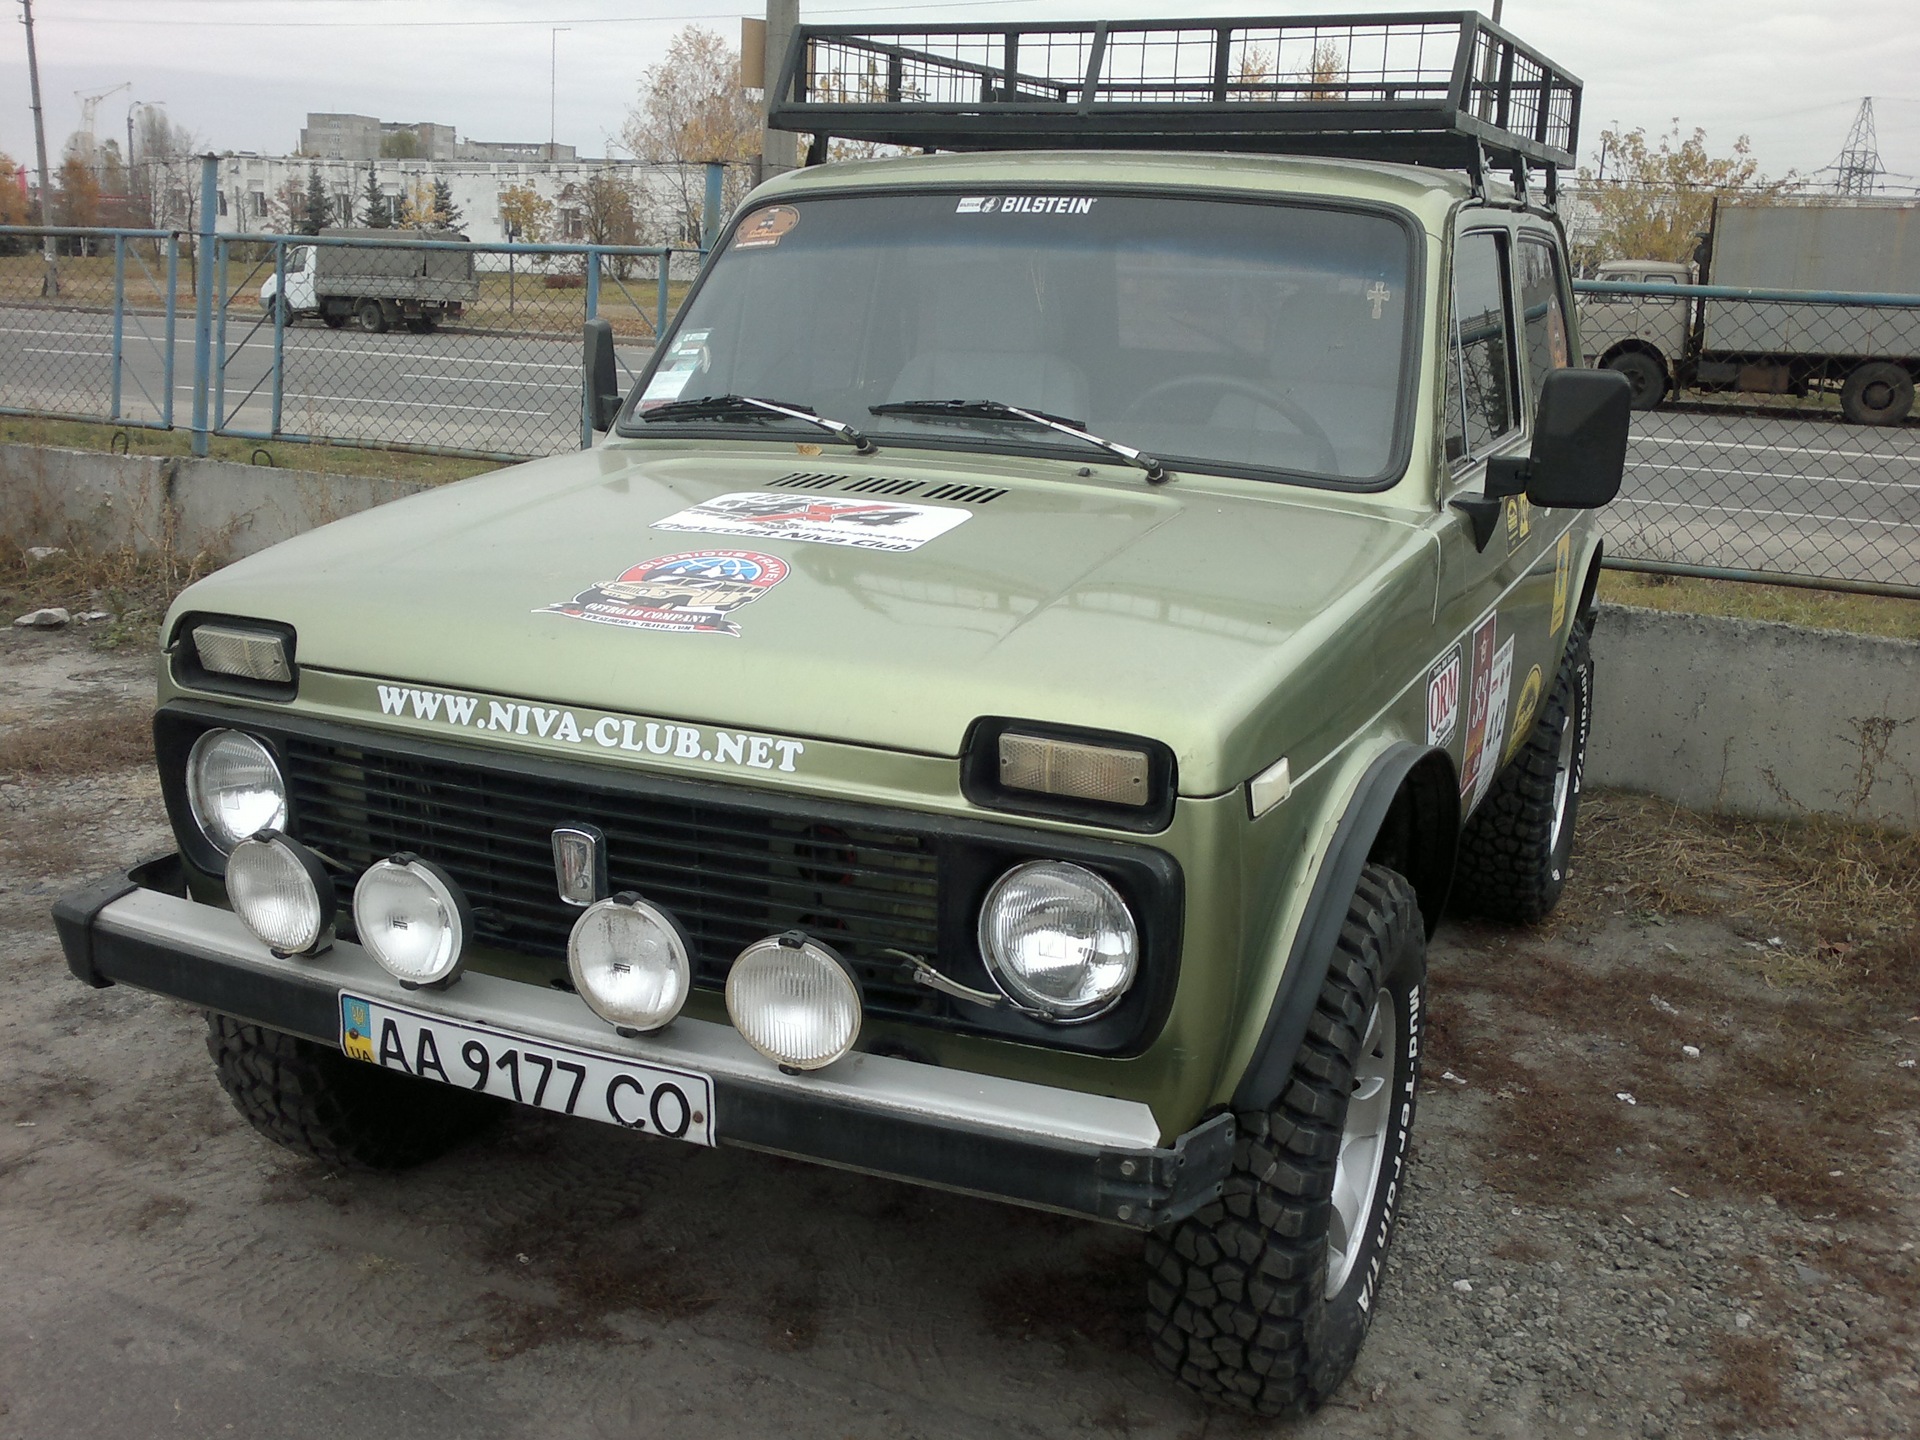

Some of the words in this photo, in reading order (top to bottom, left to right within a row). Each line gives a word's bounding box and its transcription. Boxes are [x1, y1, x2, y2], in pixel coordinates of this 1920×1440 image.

[1001, 197, 1093, 214] BILSTEIN
[650, 523, 779, 537] Chevrolet
[779, 532, 848, 543] Niva
[852, 539, 913, 551] Club
[638, 551, 748, 570] GLORIOUS
[753, 555, 781, 583] TRAVEL
[584, 602, 643, 617] OFFROAD
[643, 610, 711, 623] COMPANY
[1430, 660, 1459, 732] ORM
[377, 685, 805, 773] WWW.NIVA-CLUB.NET
[350, 1047, 373, 1063] UA
[380, 1018, 450, 1084] AA
[461, 1040, 586, 1115] 9177
[605, 1074, 691, 1139] CO
[1376, 984, 1420, 1250] Mud-Terrain
[1356, 1255, 1381, 1313] T/A
